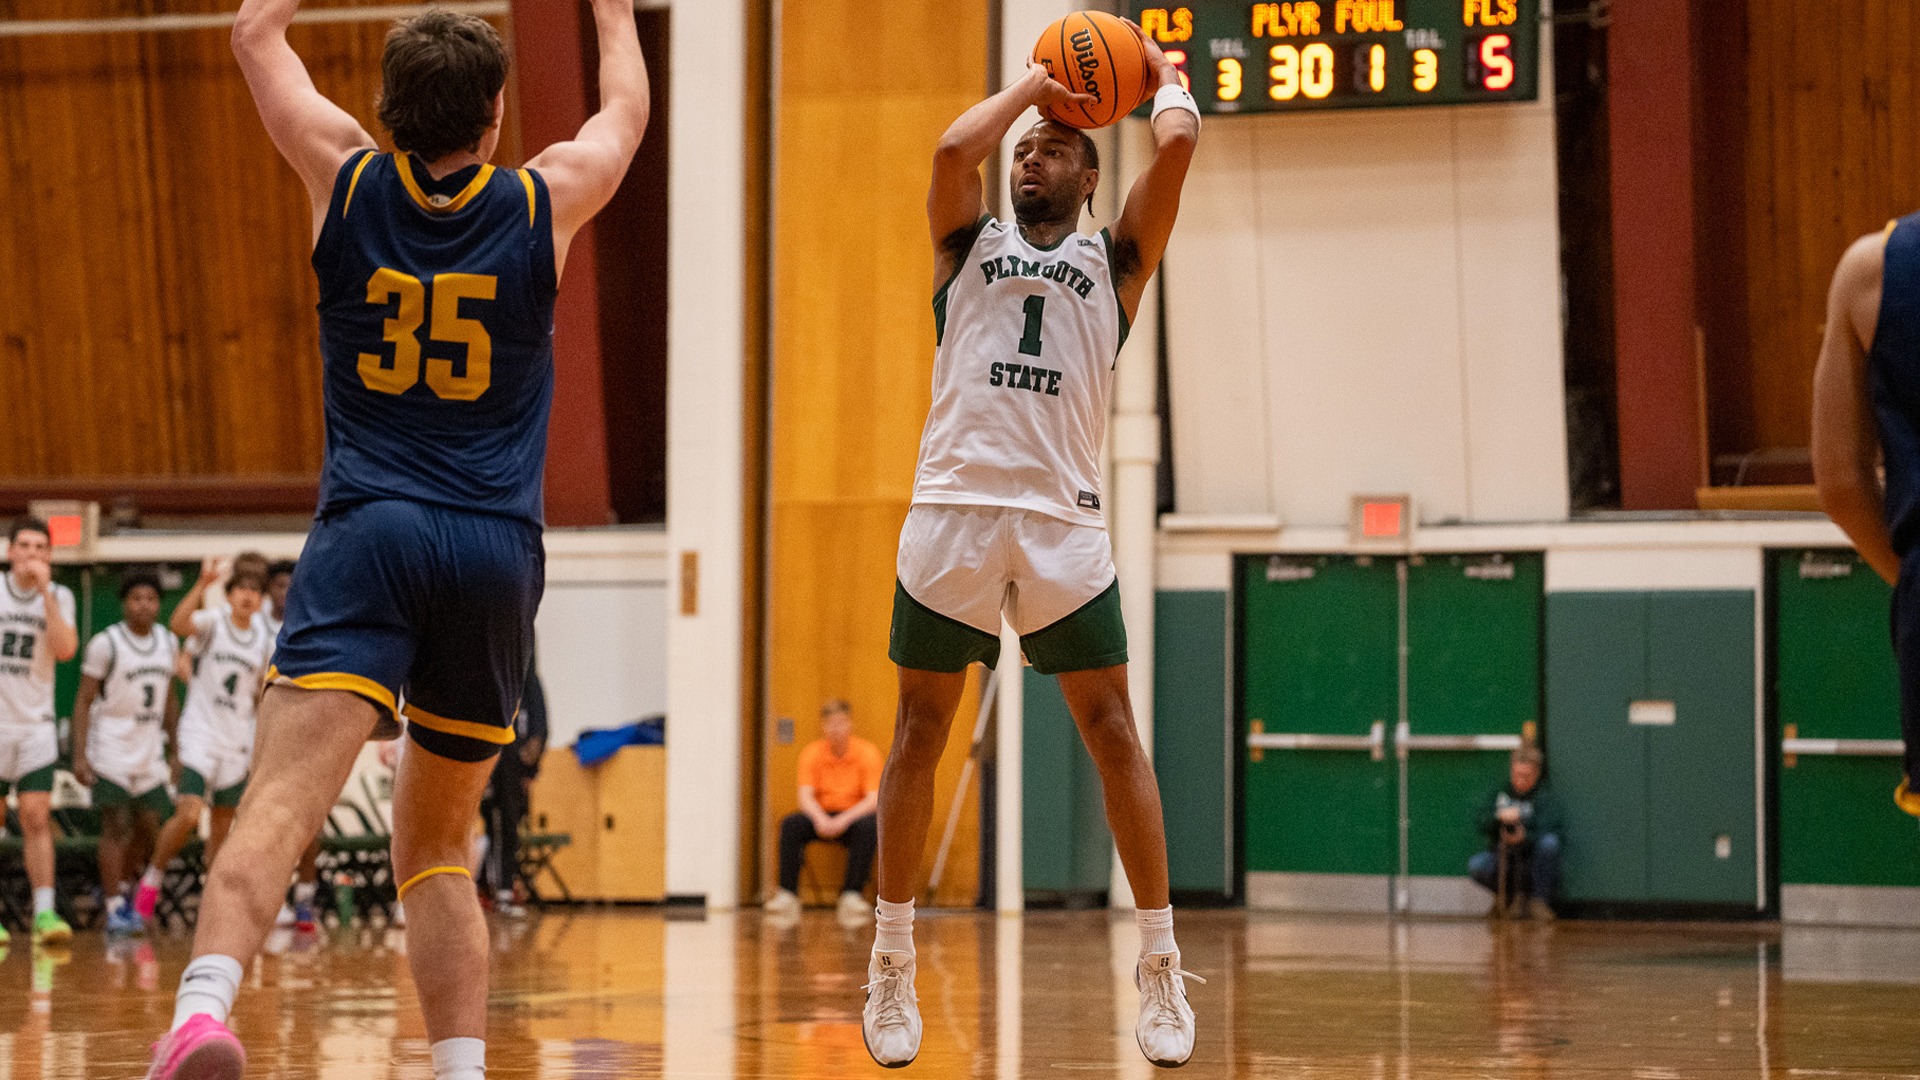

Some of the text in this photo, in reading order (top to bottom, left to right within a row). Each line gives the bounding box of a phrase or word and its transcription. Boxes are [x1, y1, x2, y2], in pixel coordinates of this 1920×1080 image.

[1141, 7, 1193, 42] FLS
[1252, 0, 1404, 37] PLYR FOUL
[1463, 0, 1517, 26] FLS
[1217, 57, 1243, 101] 3
[1269, 43, 1334, 101] 30
[1370, 44, 1385, 92] 1
[1413, 48, 1438, 92] 3
[1480, 34, 1514, 91] 5
[980, 255, 1096, 300] PLYMOUTH
[357, 267, 498, 402] 35
[1018, 294, 1046, 357] 1
[989, 361, 1063, 396] STATE
[2, 631, 36, 660] 22
